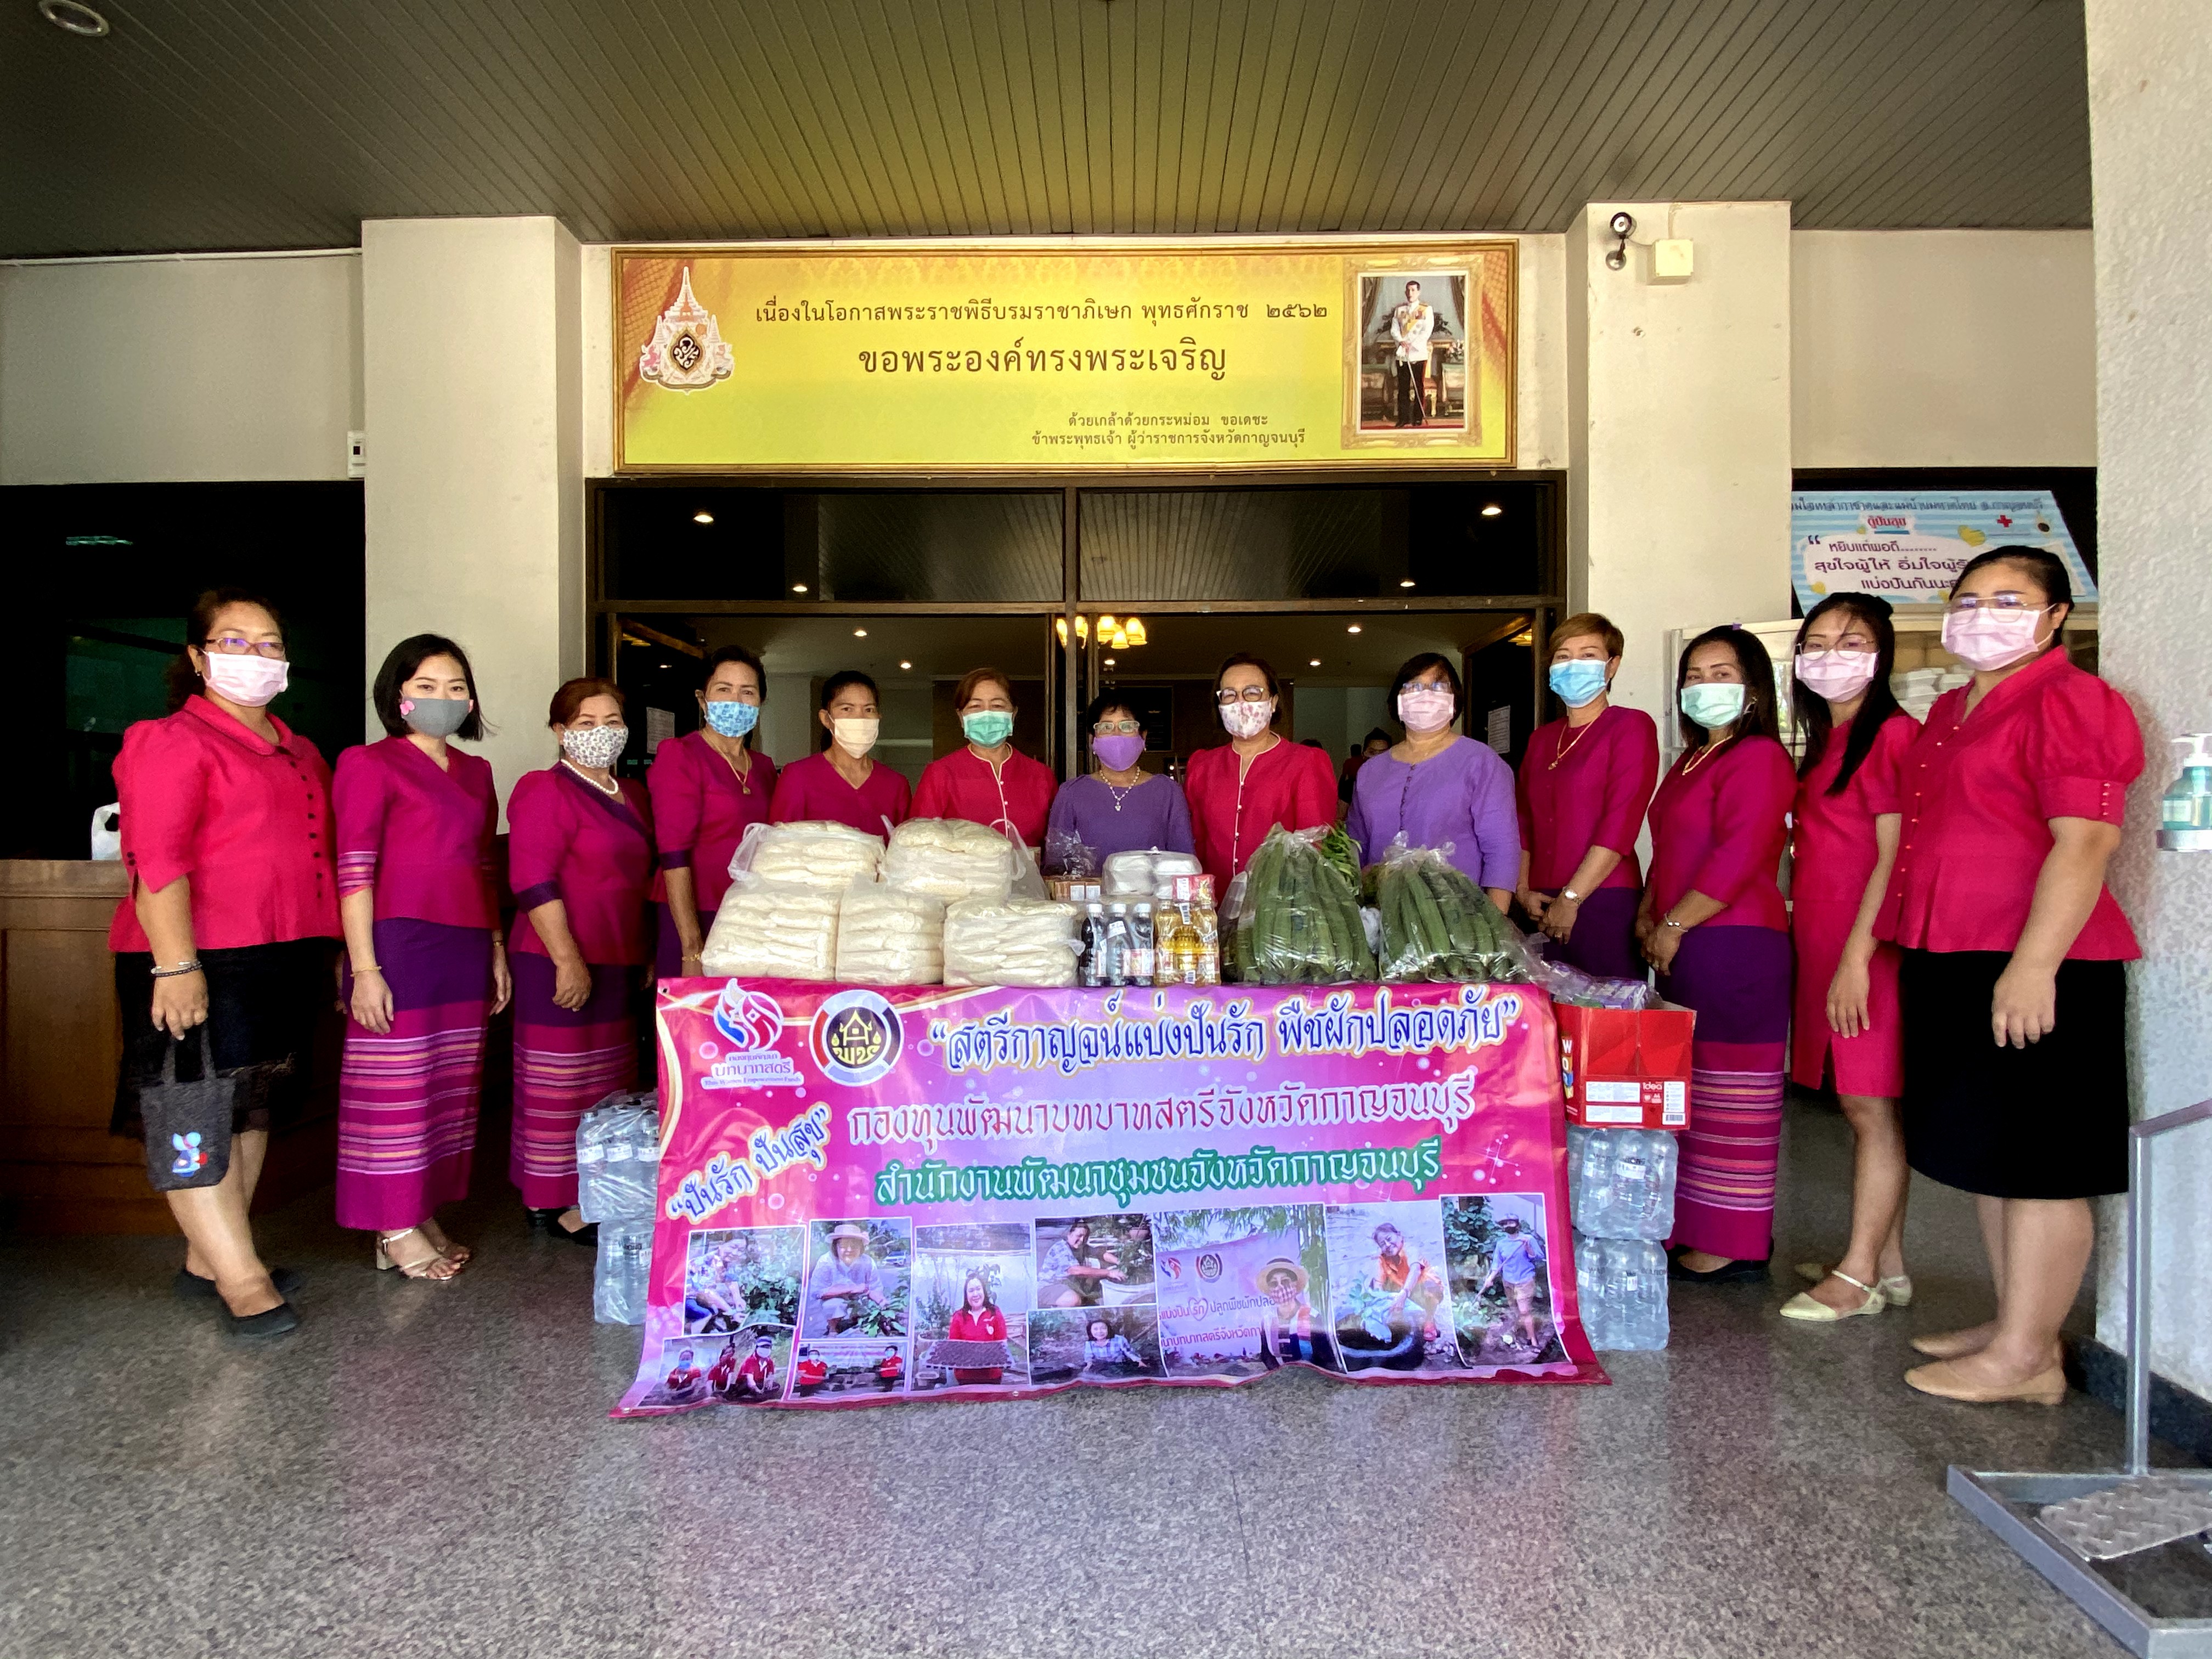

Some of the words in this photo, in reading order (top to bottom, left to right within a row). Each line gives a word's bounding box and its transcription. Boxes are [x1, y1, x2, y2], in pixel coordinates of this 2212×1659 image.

[756, 295, 1131, 322] เนื่องในโอกาสพระราชพิธีบรมราชาภิเษก
[1142, 296, 1249, 326] พุทธศักราช
[1266, 303, 1327, 318] ๒๕๖๒
[858, 336, 1226, 380] ขอพระองค์ทรงพระเจริญ
[1068, 411, 1210, 426] ด้วยเกล้าด้วยกระหม่อม
[1220, 415, 1268, 426] ขอเดชะ
[1031, 430, 1122, 449] ข้าพระพุทธเจ้า
[1127, 428, 1305, 449] ผู้ว่าราชการจังหวัดกาญจนบุรี
[1814, 557, 1891, 573] สุขใจผู้ให้
[1898, 556, 1968, 572] อิ่มใจผู้รั
[851, 1075, 1472, 1151] กองทุนพัฒนาบทบาทสตรีจังหวัดกาญจนบุรี
[877, 1138, 1441, 1205] สำนักงานพัฒนาชุมชนจังหวัดกาญจนบุรี
